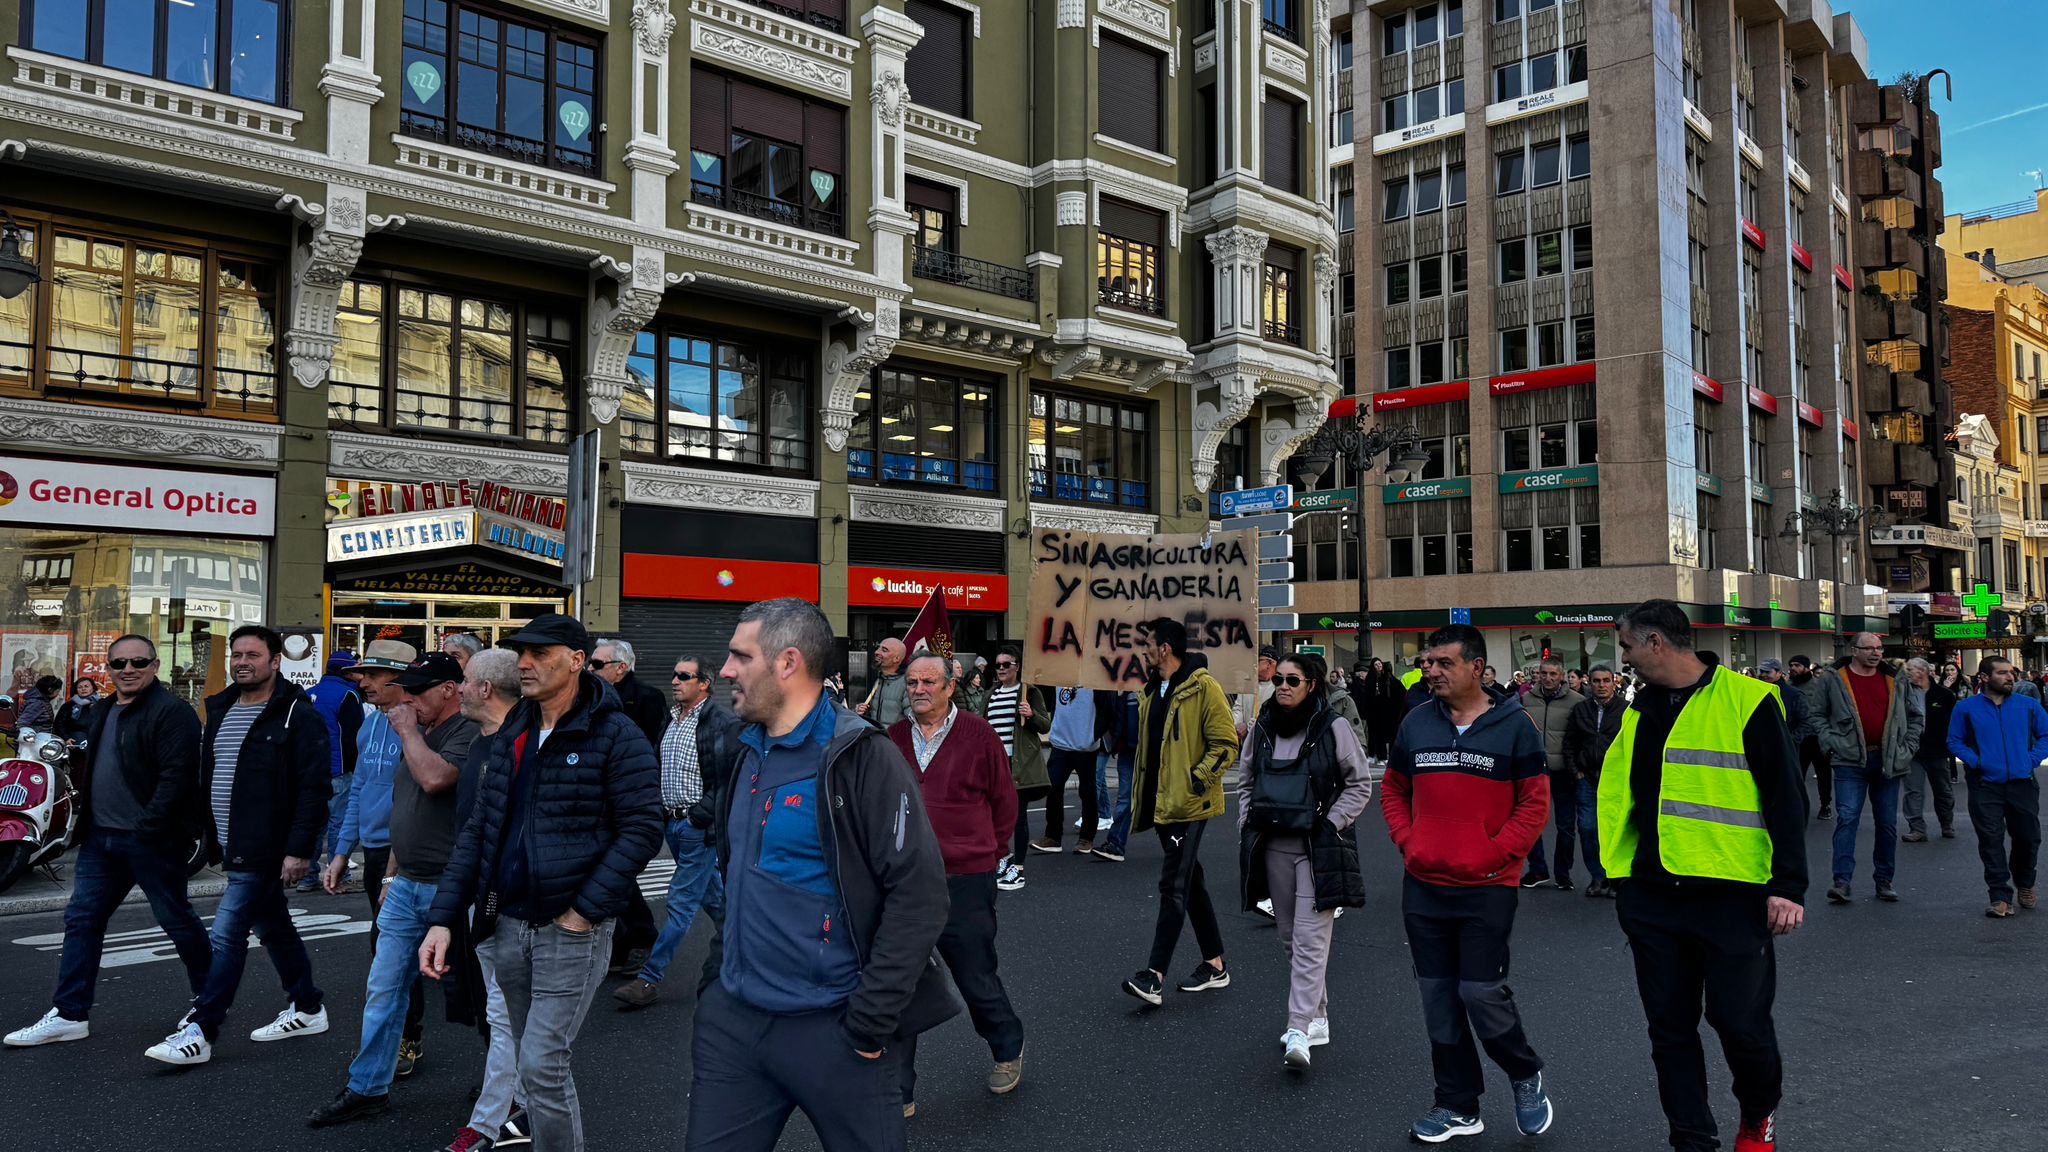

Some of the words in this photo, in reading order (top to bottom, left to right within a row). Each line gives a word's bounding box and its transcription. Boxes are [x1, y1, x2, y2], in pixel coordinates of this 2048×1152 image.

[1529, 93, 1555, 103] REALE
[1412, 124, 1435, 134] REALE
[1523, 473, 1562, 487] caser
[1562, 475, 1588, 485] seguros
[29, 479, 154, 509] General
[163, 488, 257, 517] Optica
[1405, 484, 1440, 499] caser
[1439, 487, 1463, 497] seguros
[362, 486, 396, 517] EL
[1300, 495, 1331, 507] caser
[341, 520, 466, 554] CONFITERIA
[491, 523, 567, 559] HELADER
[458, 564, 478, 574] EL
[405, 572, 523, 585] VALENCIANO
[353, 580, 459, 593] HELADERIA
[887, 579, 923, 594] luckia
[925, 586, 945, 597] spt
[947, 585, 964, 597] café
[1055, 573, 1082, 607] Y
[1335, 620, 1359, 629] Unicaja
[1555, 614, 1588, 625] Unicaja
[1588, 613, 1614, 623] Banco
[1042, 616, 1083, 656] LA
[1095, 618, 1149, 651] MES
[1935, 626, 1971, 636] Solicite
[1973, 626, 1986, 635] su
[1415, 752, 1459, 763] NORDIC
[1460, 752, 1495, 768] RUNS
